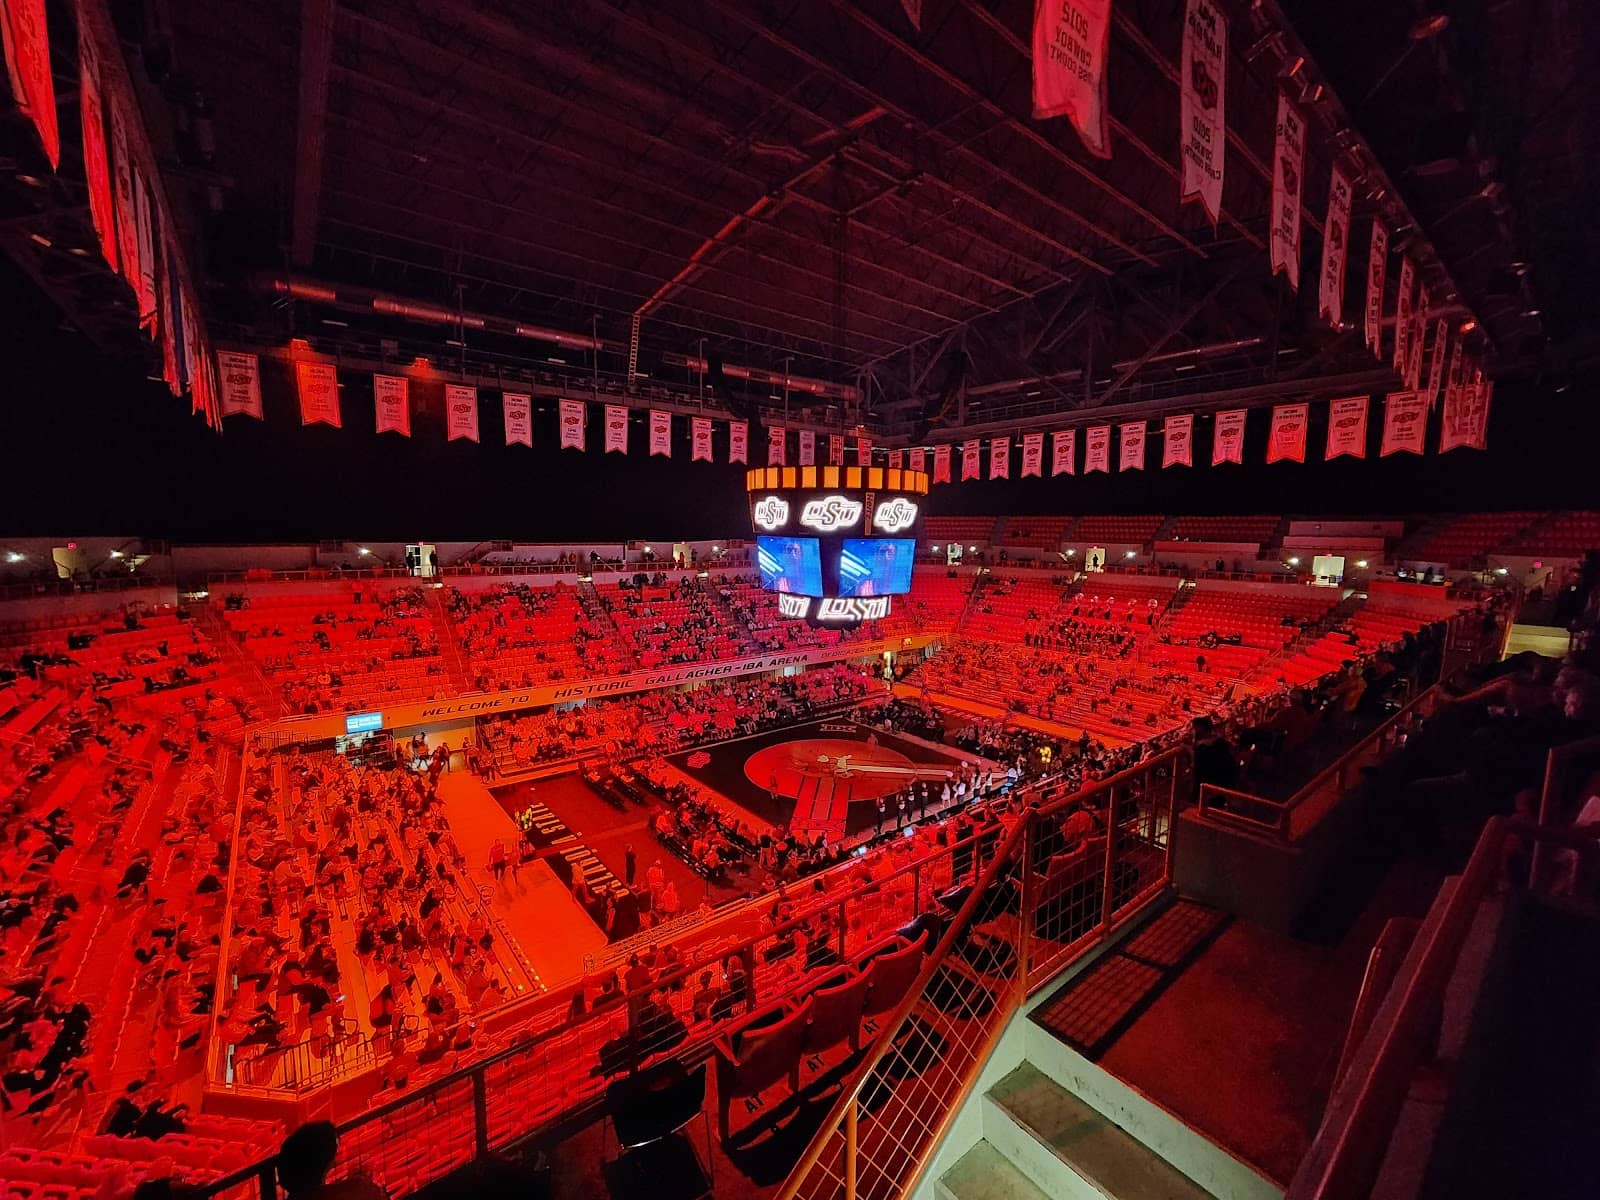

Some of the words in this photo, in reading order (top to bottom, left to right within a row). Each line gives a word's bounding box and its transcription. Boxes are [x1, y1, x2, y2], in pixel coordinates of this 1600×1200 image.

[804, 498, 860, 528] OSU
[422, 701, 503, 717] WELCOME
[509, 695, 530, 704] TO
[554, 679, 634, 699] HISTORIC
[769, 654, 808, 667] ARENA
